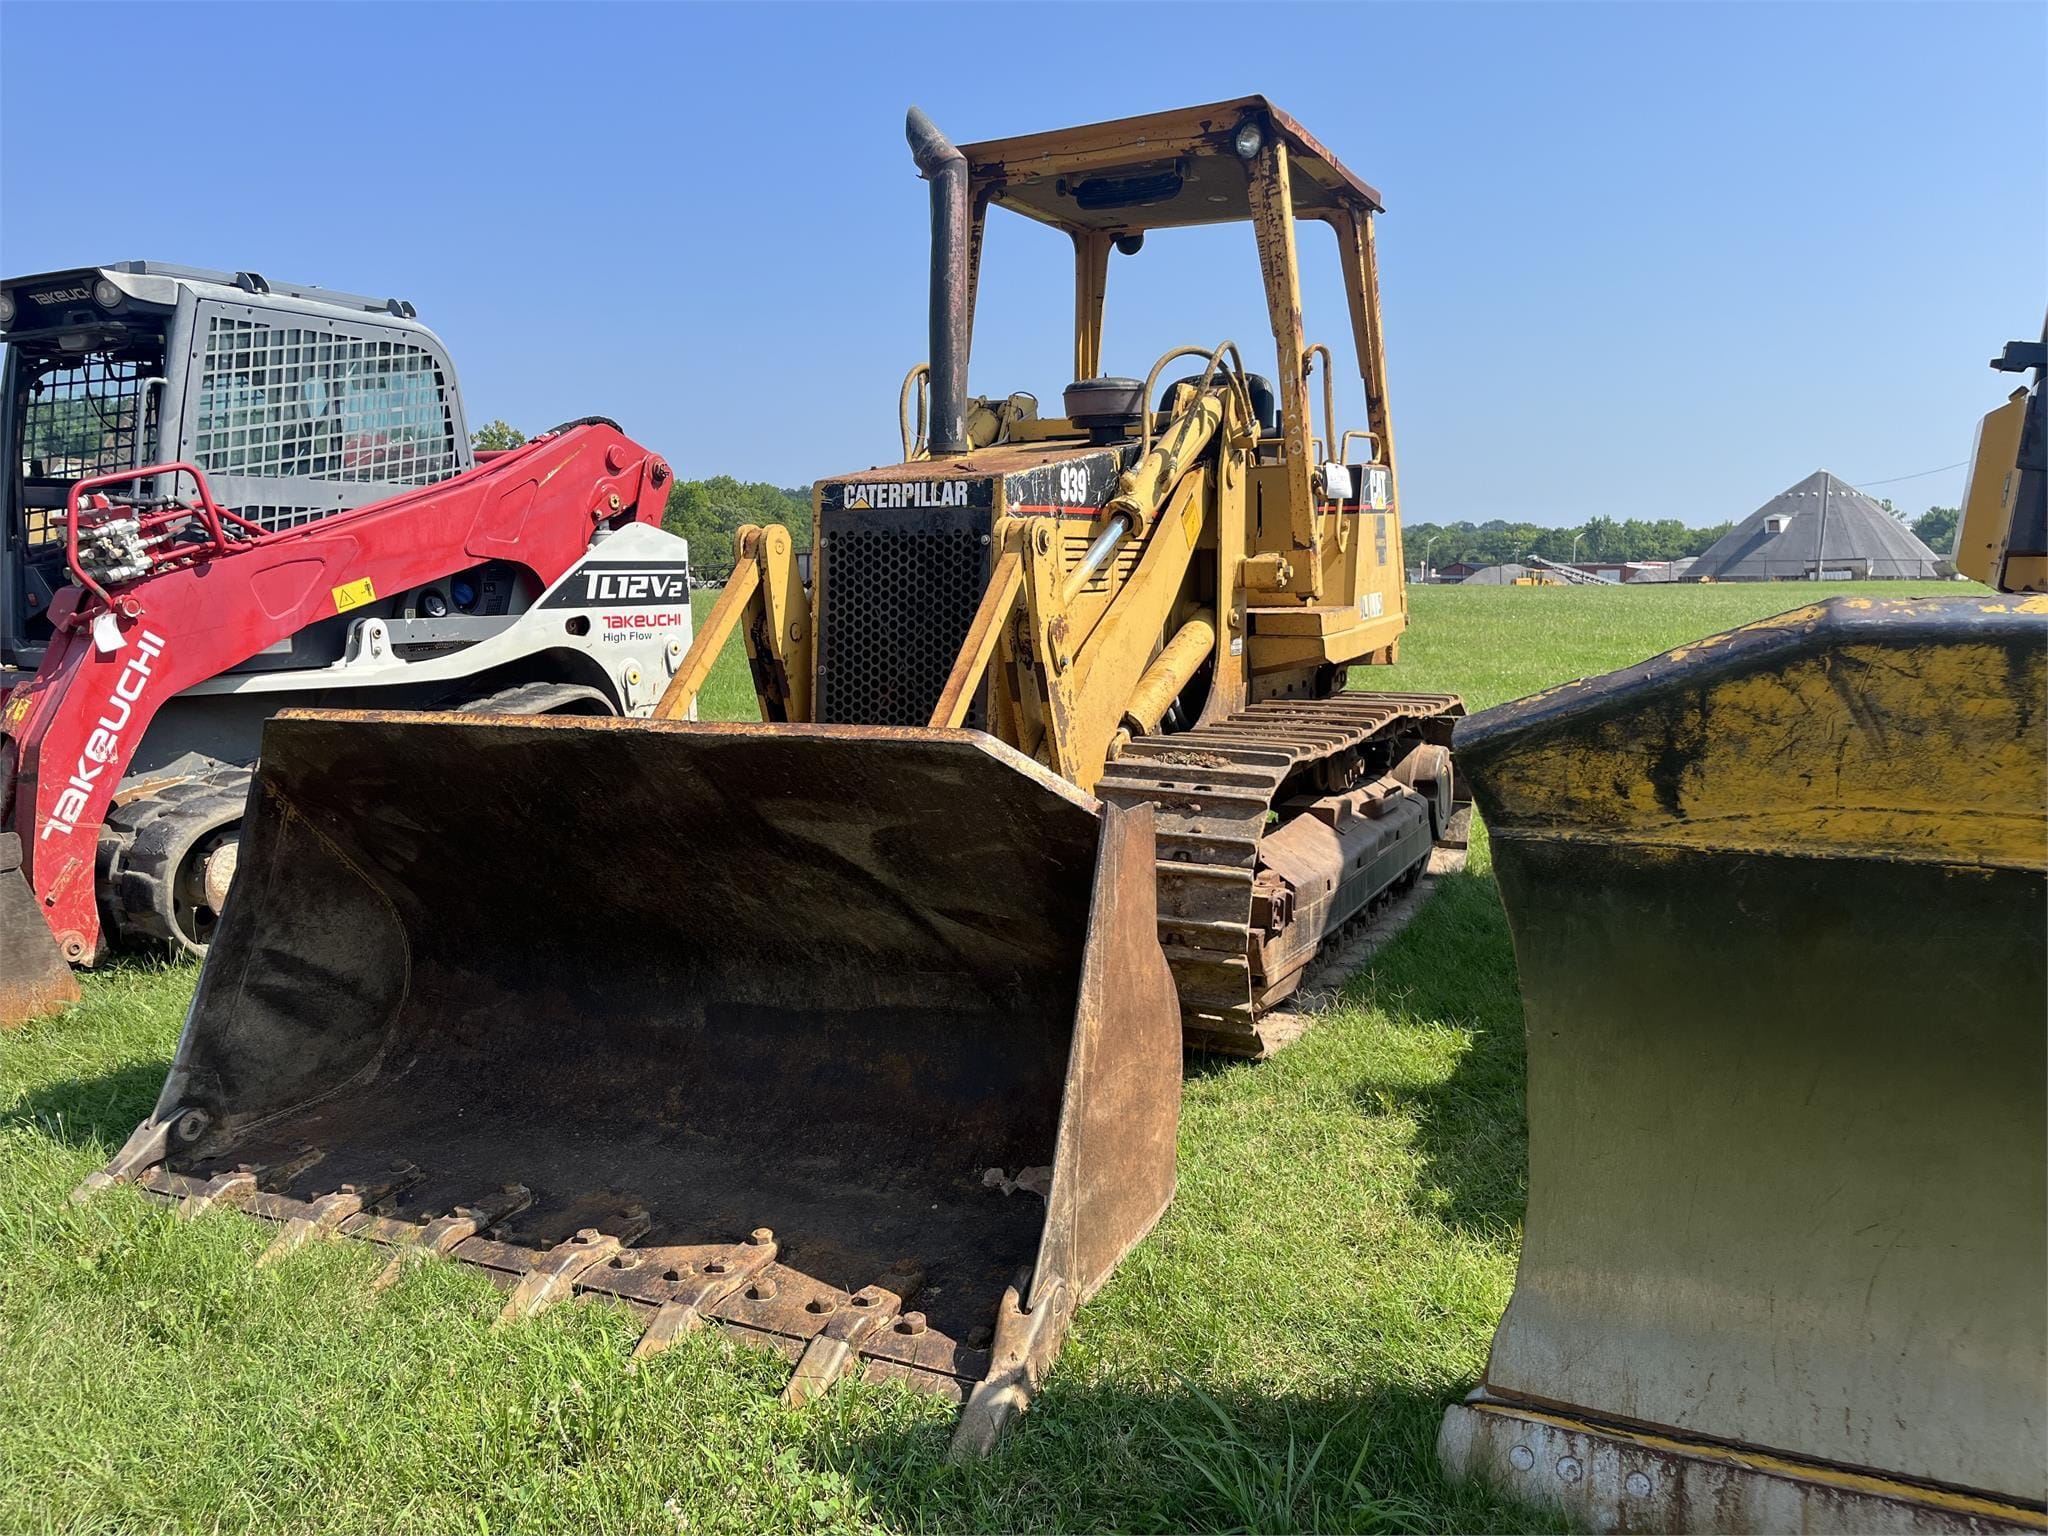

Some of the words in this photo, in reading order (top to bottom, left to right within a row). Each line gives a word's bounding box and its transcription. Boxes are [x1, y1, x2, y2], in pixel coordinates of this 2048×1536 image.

[29, 287, 91, 306] TAKEUC
[843, 480, 968, 509] CATERPILLAR
[1060, 466, 1087, 501] 939
[583, 569, 685, 600] TL12V2
[602, 613, 681, 629] TAKEUCHI
[603, 632, 627, 643] High
[629, 631, 653, 641] Flow
[41, 630, 166, 841] TAKEUCHI
